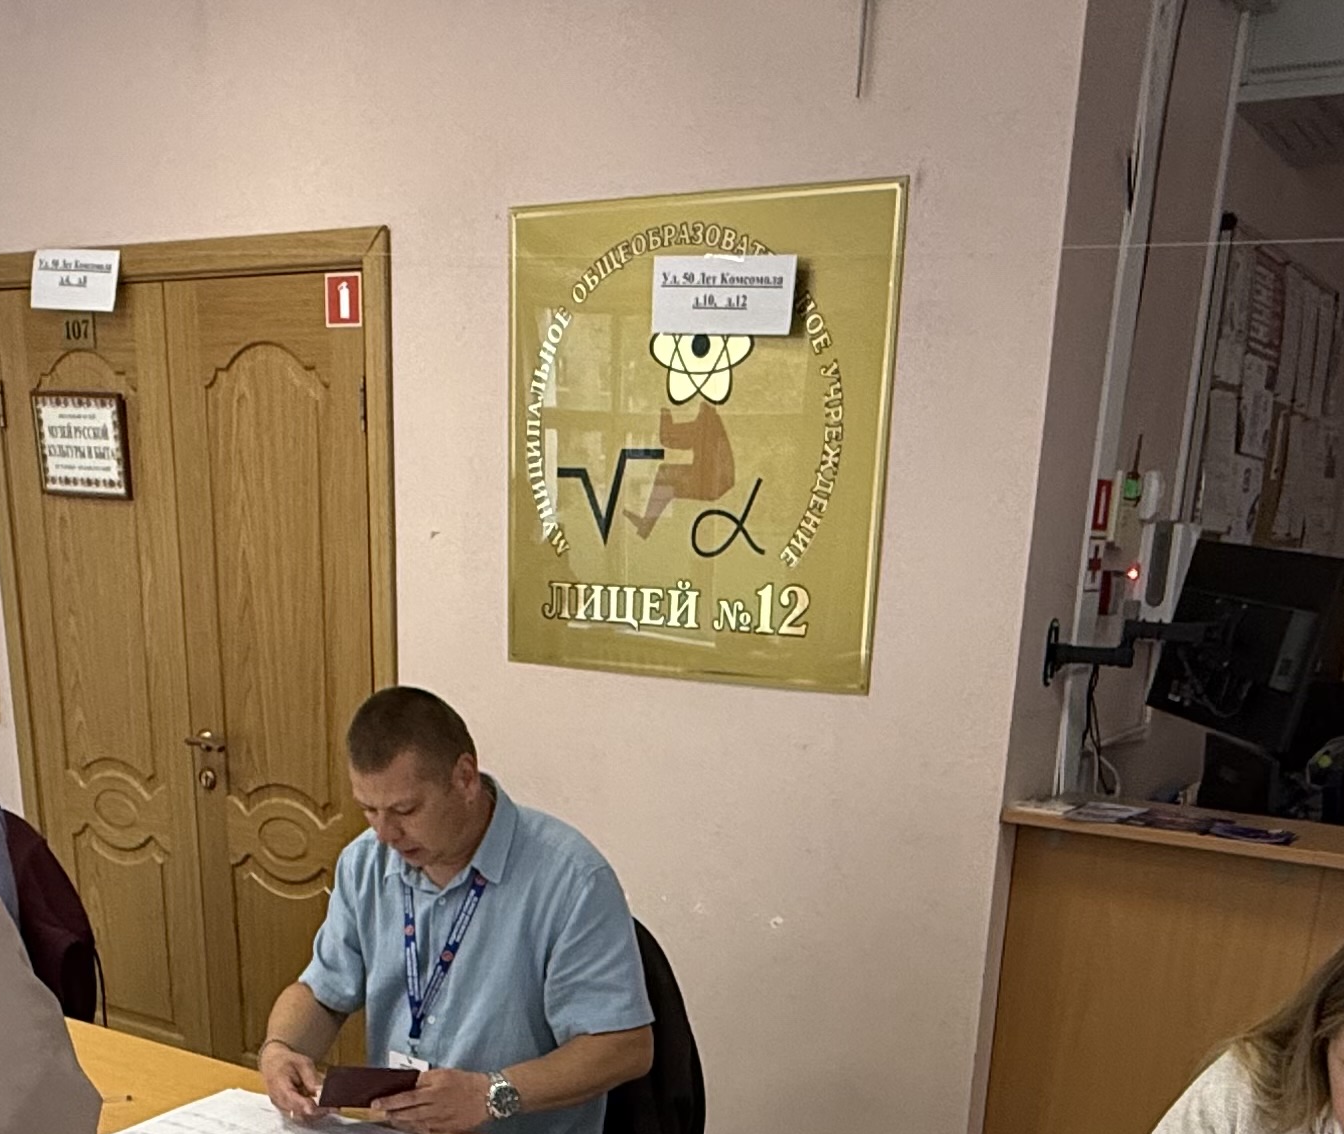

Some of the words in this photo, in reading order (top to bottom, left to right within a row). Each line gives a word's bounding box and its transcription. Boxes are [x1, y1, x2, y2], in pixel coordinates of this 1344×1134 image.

[662, 271, 680, 285] Ул.
[682, 272, 695, 285] 50
[696, 272, 718, 286] Лет
[720, 271, 784, 286] Комсомола
[724, 293, 748, 308] д.12
[65, 319, 90, 341] 107
[73, 422, 110, 441] РУССКОЙ
[525, 305, 573, 557] МУНИЦИПАЛЬНОЕ
[780, 358, 845, 569] УЧРЕЖДЕНИЕ
[541, 580, 702, 633] ЛИЦЕЙ
[712, 582, 811, 638] №12
